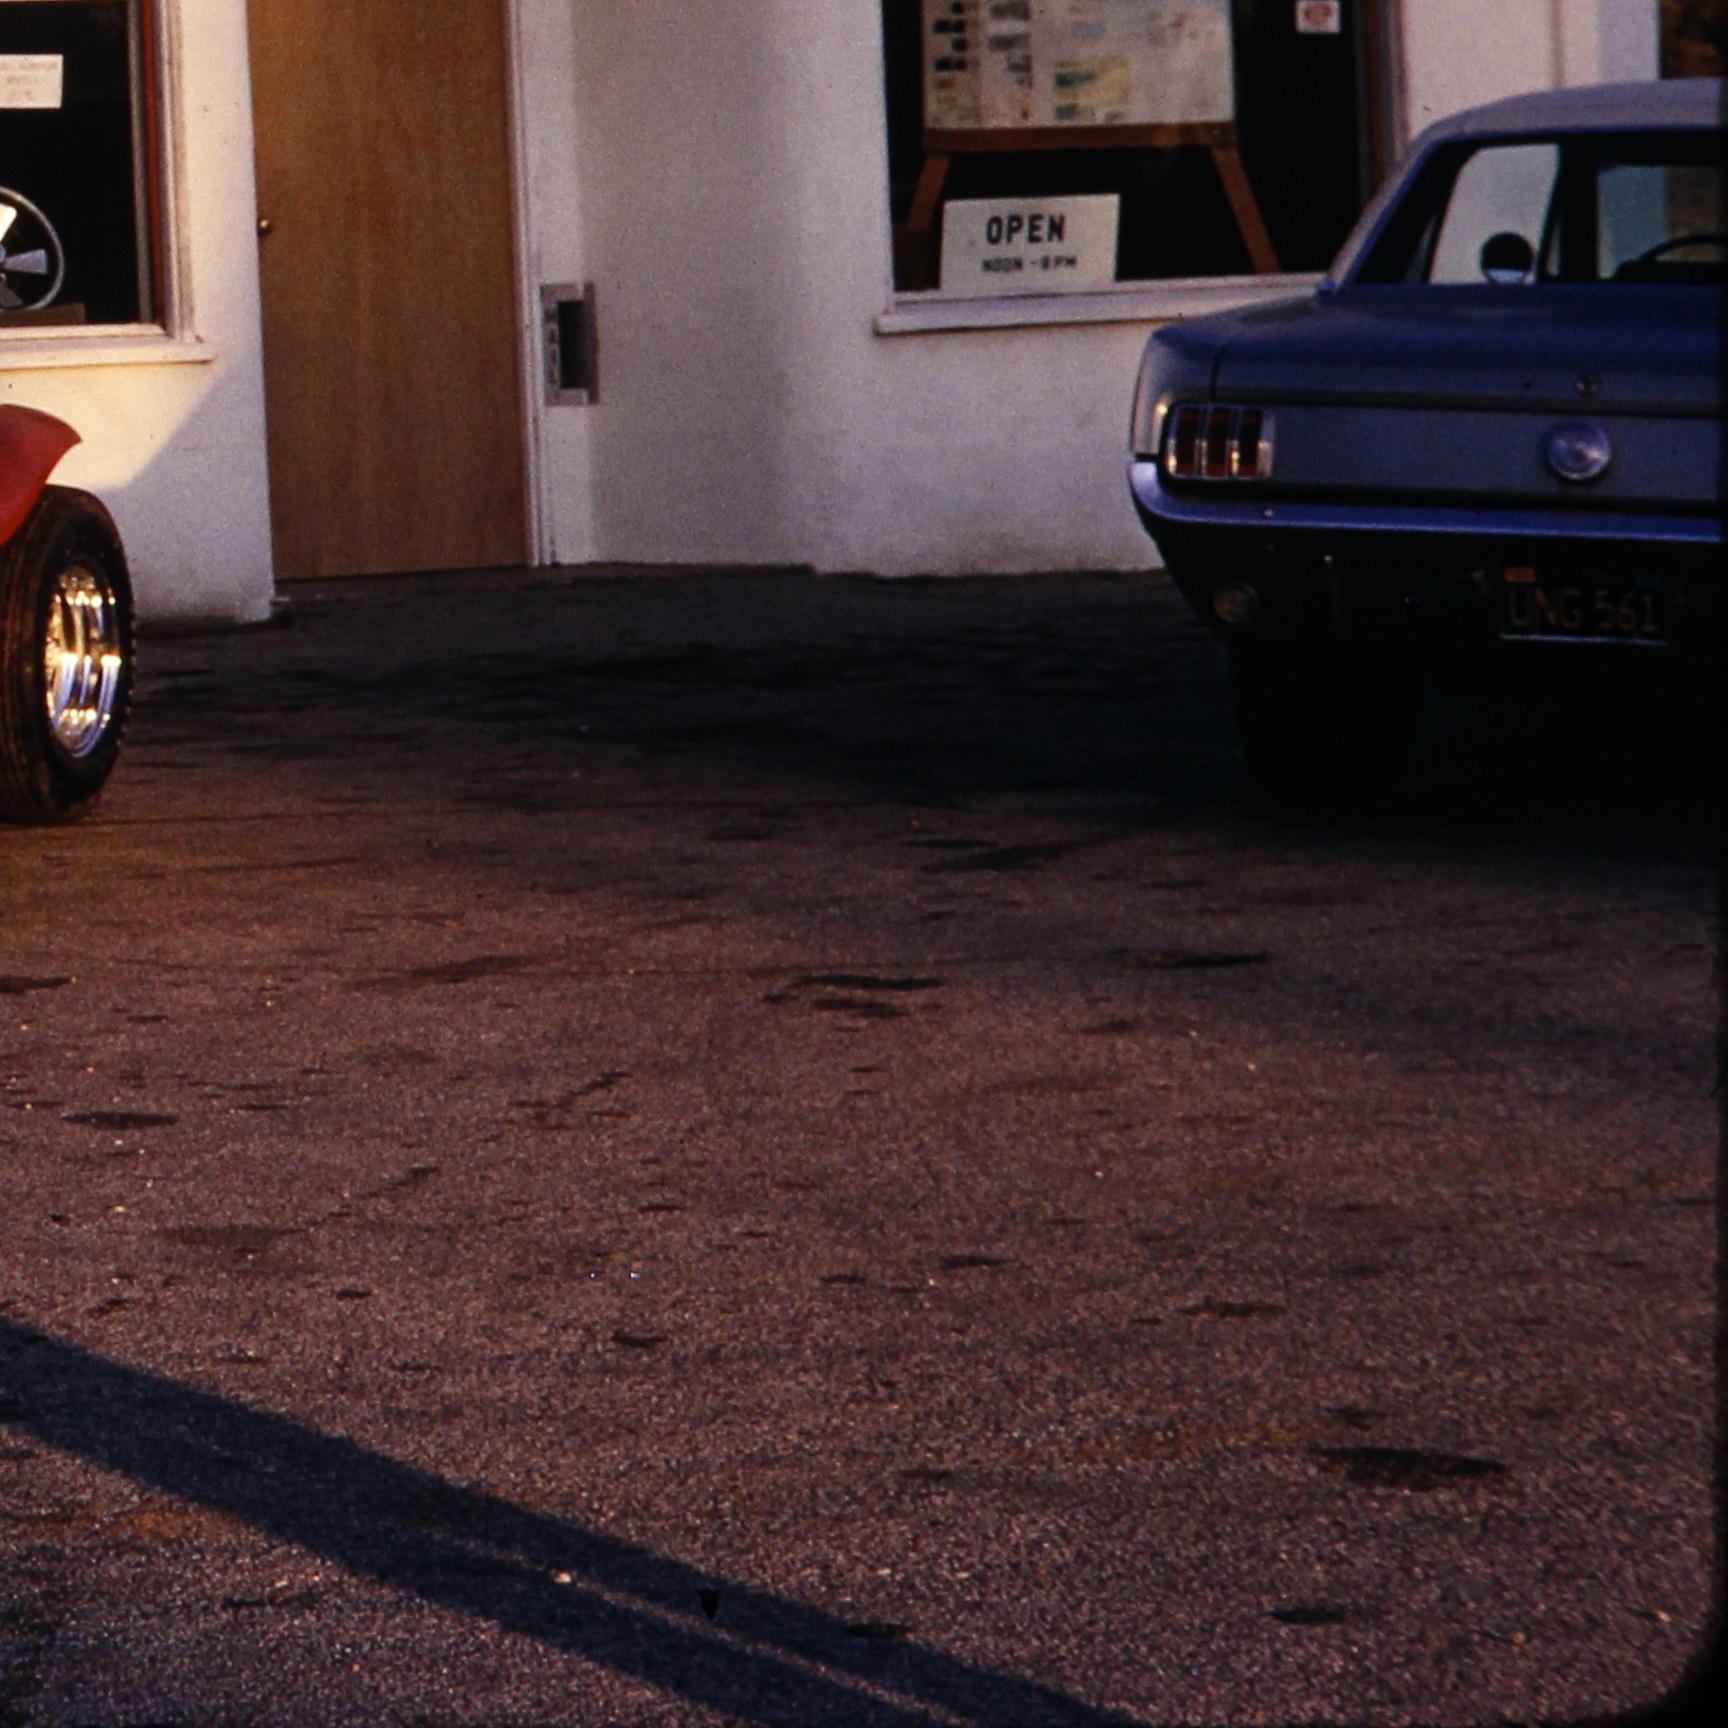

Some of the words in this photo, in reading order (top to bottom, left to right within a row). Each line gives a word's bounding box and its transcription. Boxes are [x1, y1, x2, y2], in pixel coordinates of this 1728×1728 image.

[986, 212, 1066, 245] OPEN
[981, 256, 1024, 273] NOON
[1508, 586, 1582, 629] UNG
[1595, 587, 1658, 632] 561
